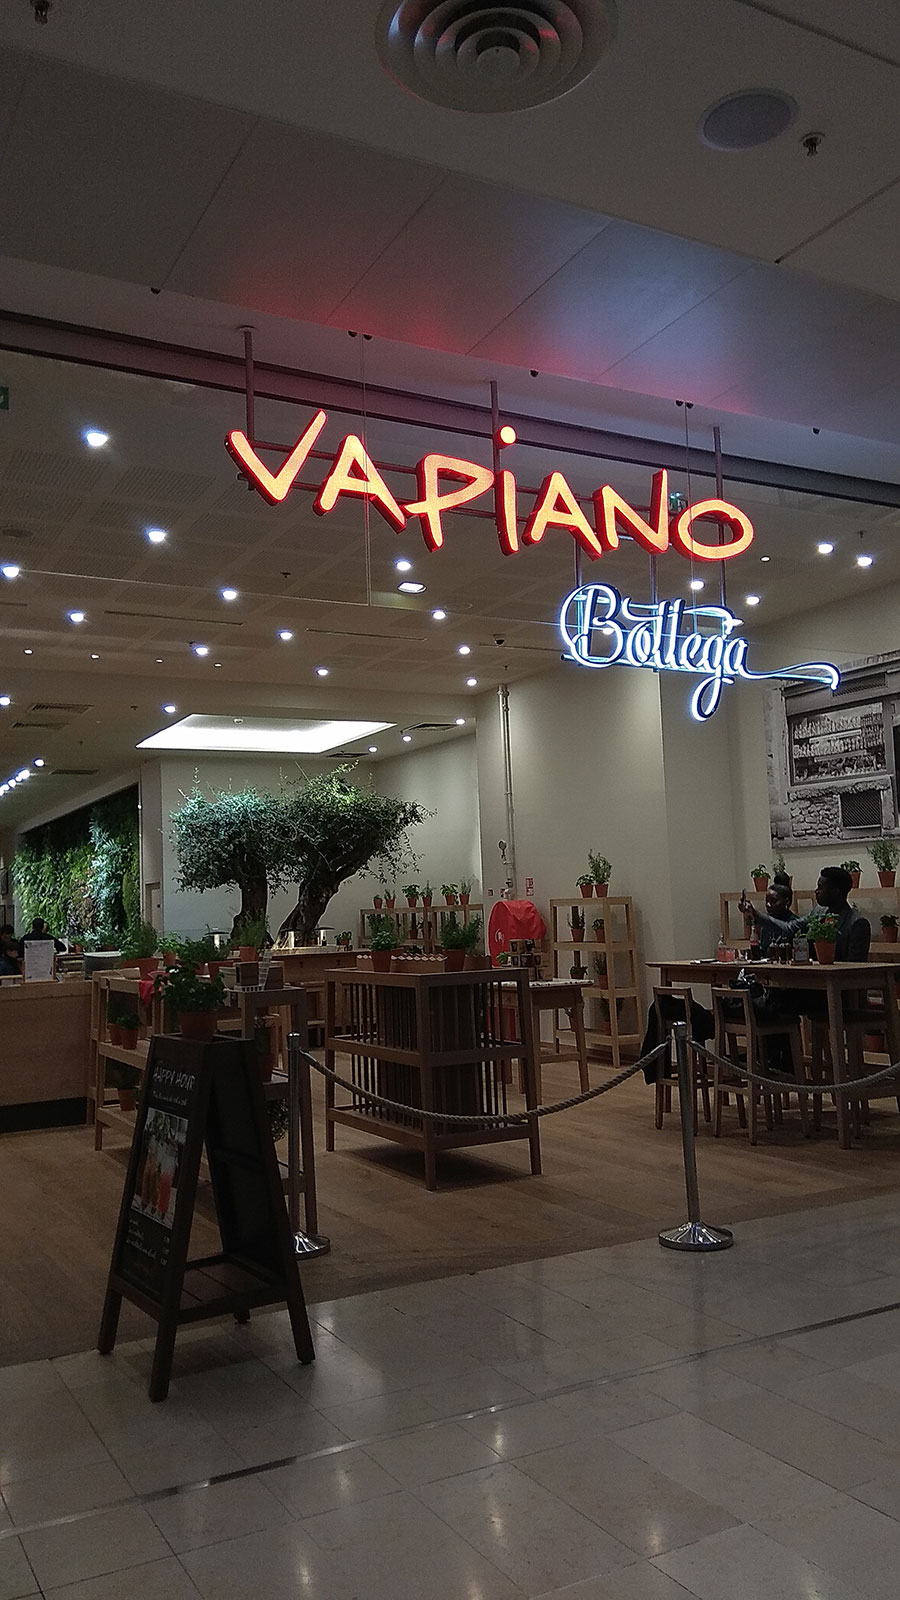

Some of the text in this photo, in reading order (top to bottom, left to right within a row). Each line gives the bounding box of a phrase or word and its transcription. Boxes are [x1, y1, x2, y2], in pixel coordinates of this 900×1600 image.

[560, 582, 840, 722] Bottega
[153, 1066, 196, 1091] HAPPY HOUR
